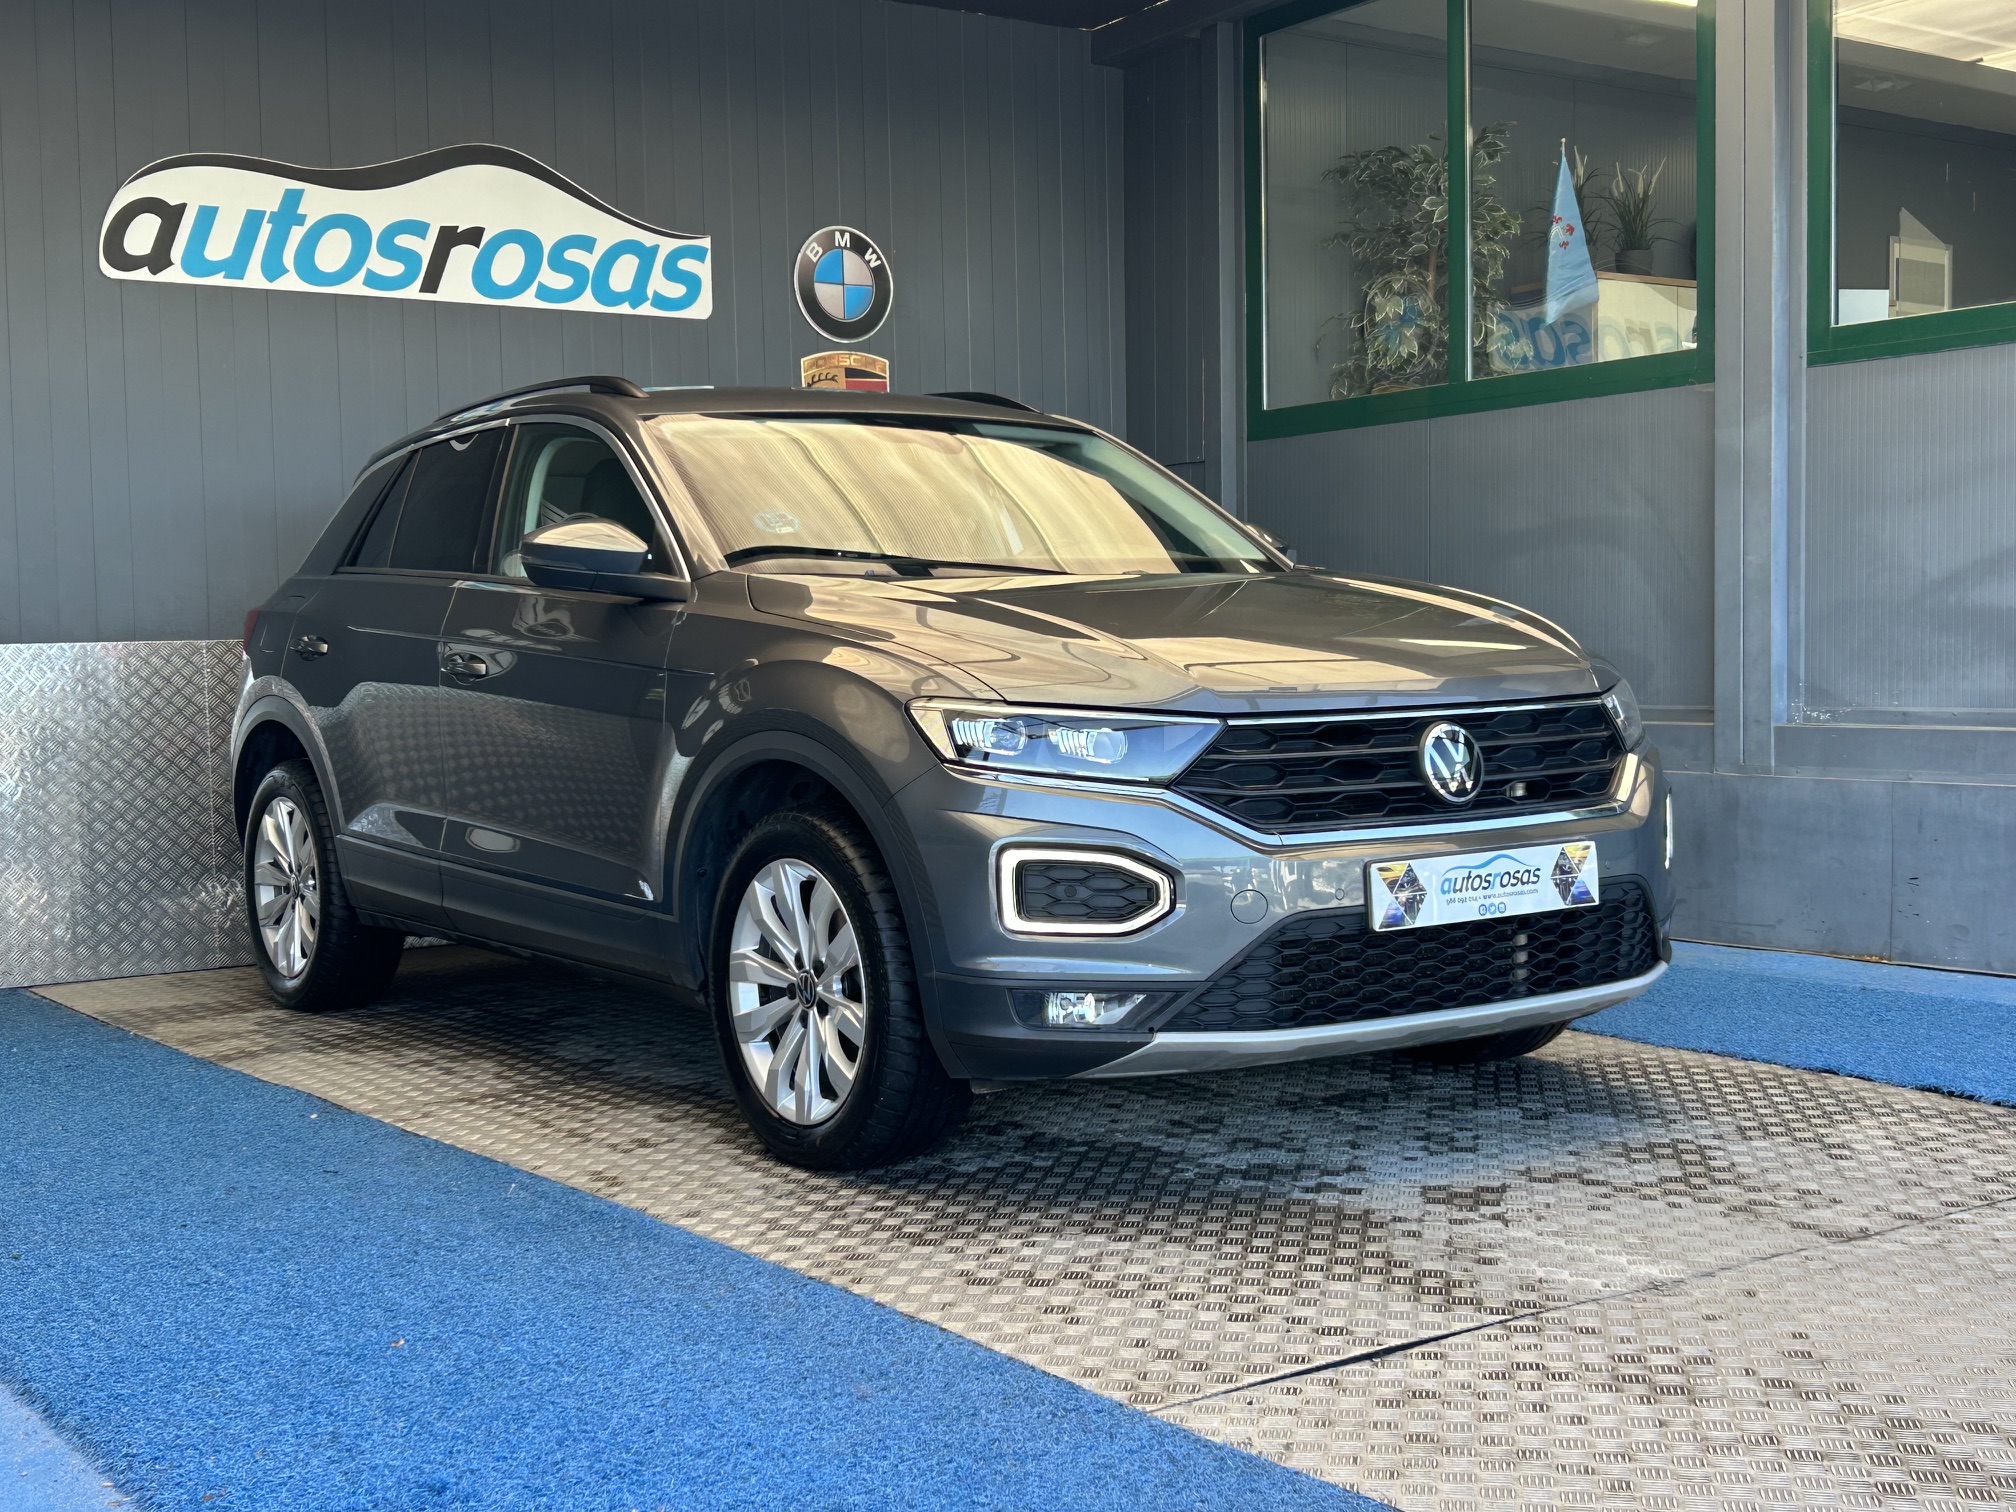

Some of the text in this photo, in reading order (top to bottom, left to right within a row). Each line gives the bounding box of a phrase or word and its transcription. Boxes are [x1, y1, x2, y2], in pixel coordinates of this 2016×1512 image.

[102, 188, 709, 312] autosrosas
[805, 230, 882, 270] BMW
[1440, 867, 1541, 895] autosrosas
